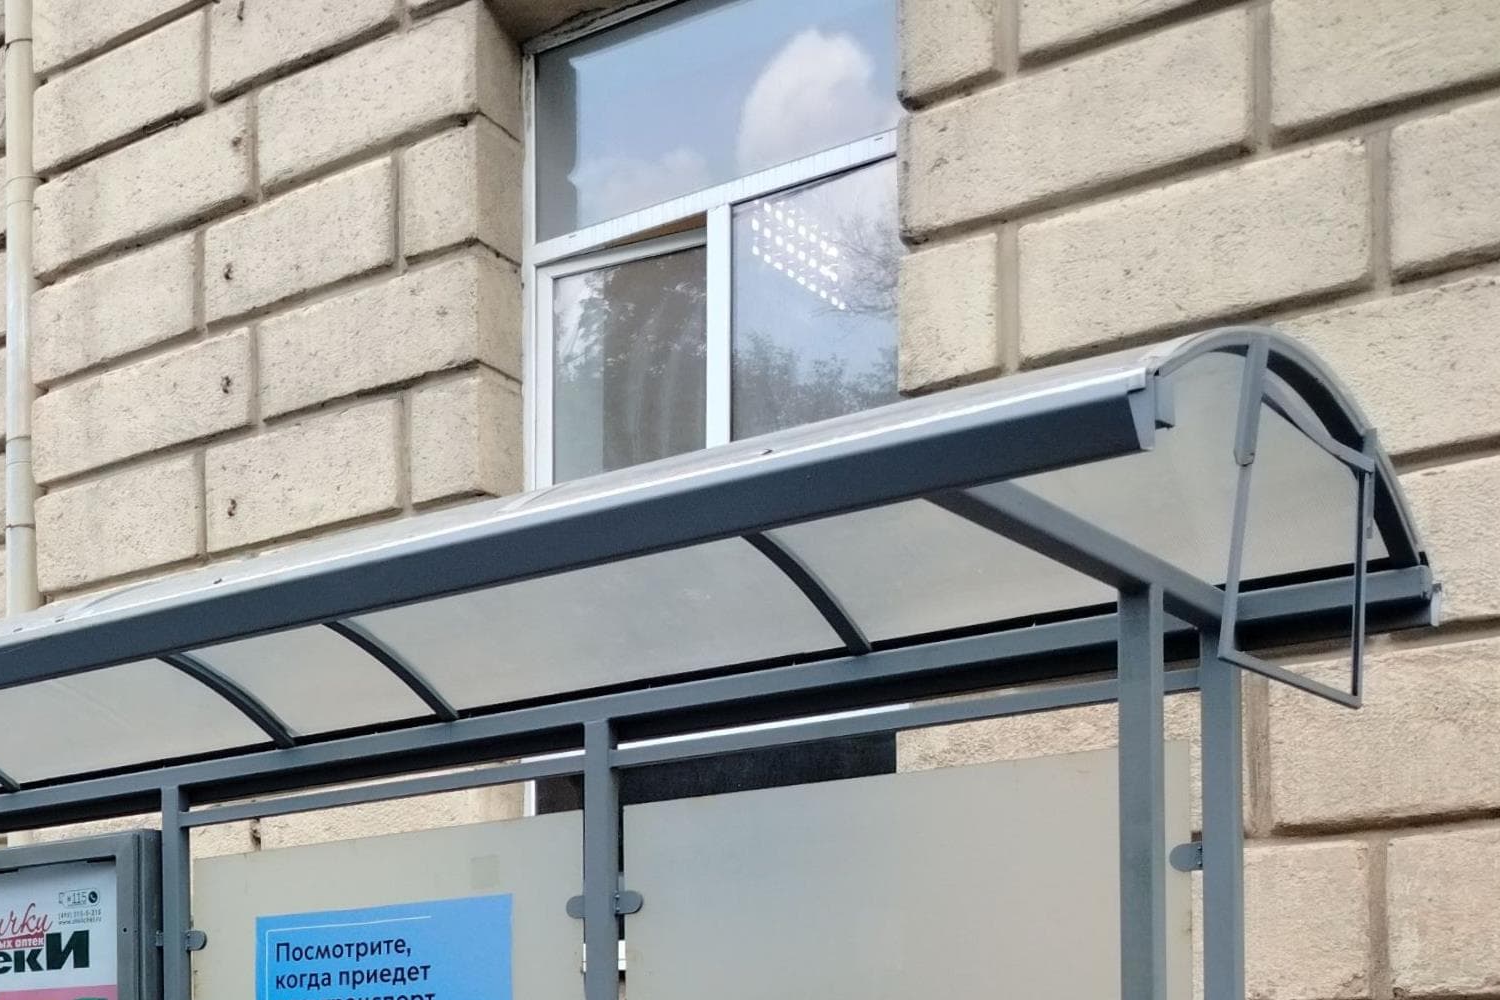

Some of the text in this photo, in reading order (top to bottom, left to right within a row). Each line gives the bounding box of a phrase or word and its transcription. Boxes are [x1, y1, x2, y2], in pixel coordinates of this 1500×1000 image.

[14, 937, 45, 948] аптек
[275, 938, 412, 962] Посмотрите,
[275, 964, 431, 991] когда приедет
